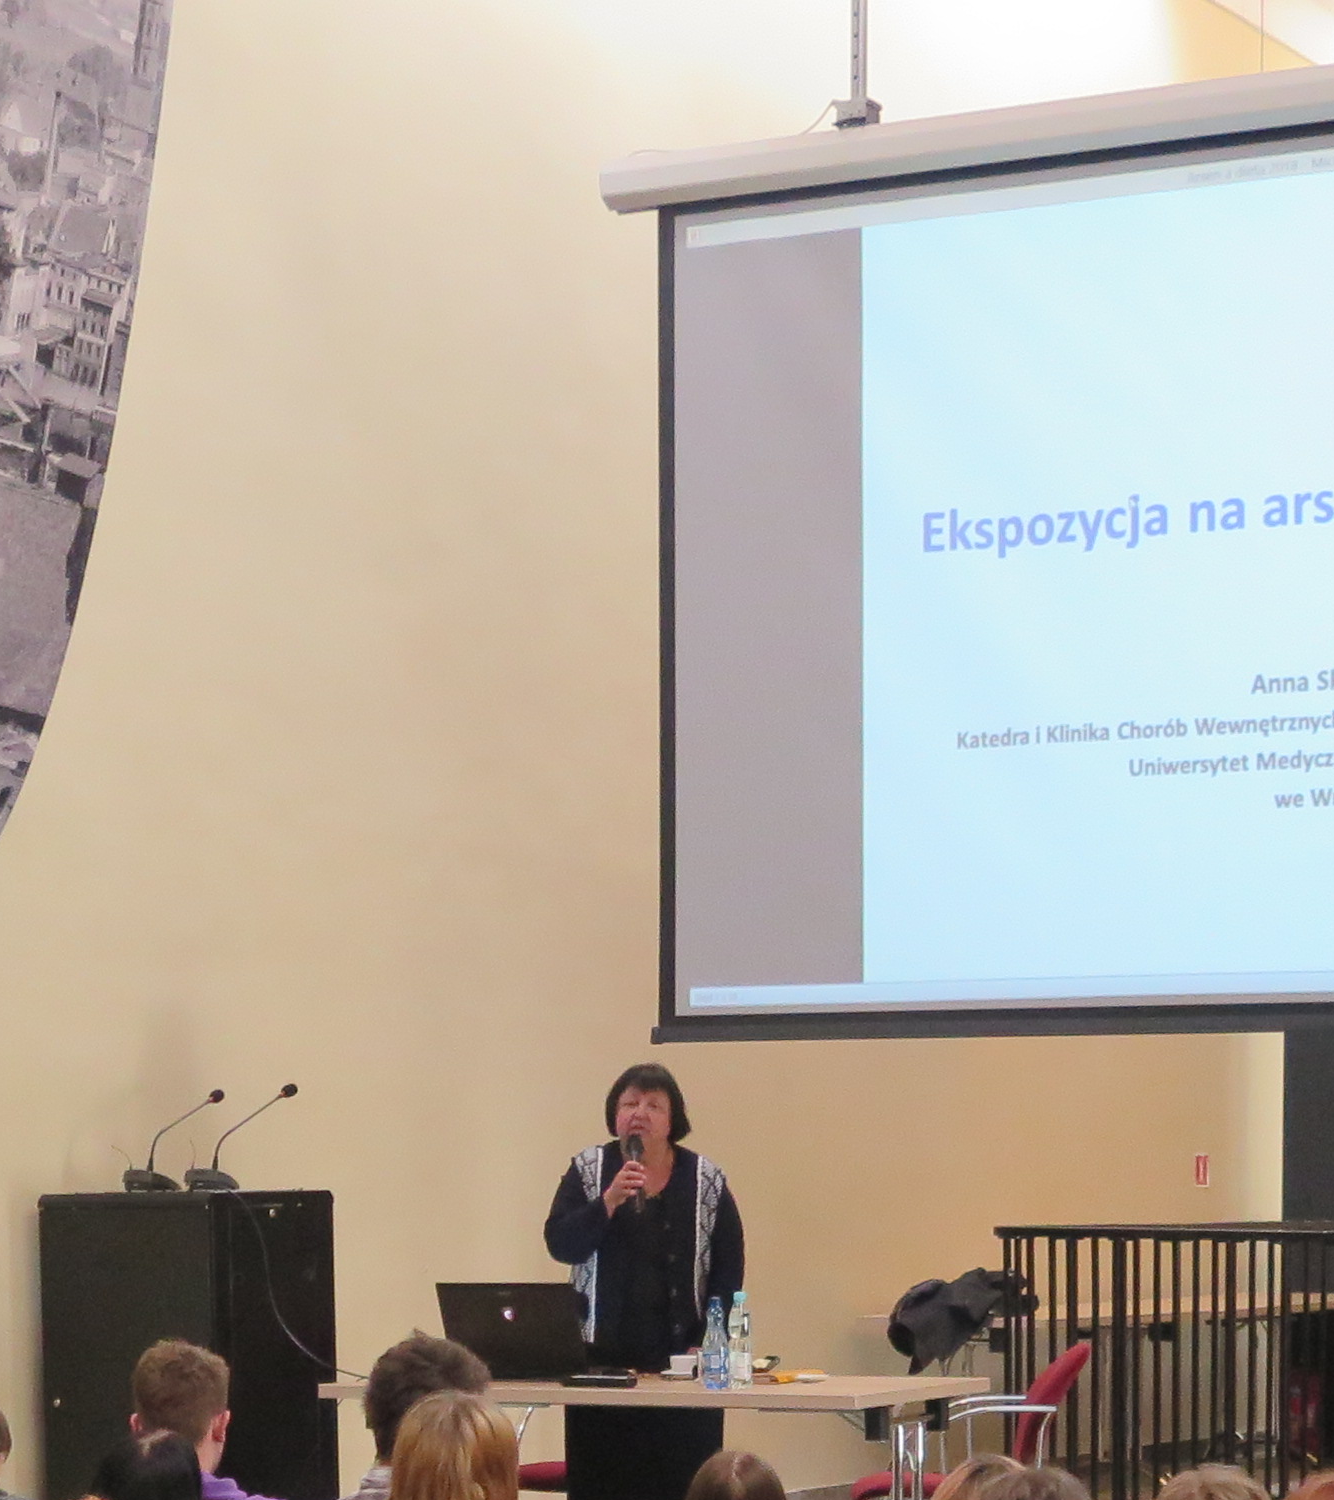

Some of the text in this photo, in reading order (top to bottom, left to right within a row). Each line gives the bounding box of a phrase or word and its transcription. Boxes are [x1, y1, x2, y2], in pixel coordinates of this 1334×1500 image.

[923, 494, 1169, 559] Ekspozycja
[1189, 497, 1246, 534] na
[1250, 673, 1310, 695] Anna
[956, 727, 1030, 750] Katedra
[1035, 725, 1041, 744] i
[1046, 722, 1110, 744] Klinika
[1117, 717, 1188, 740] Chorób
[1128, 754, 1250, 778] Uniwersytet
[1274, 792, 1305, 809] we
